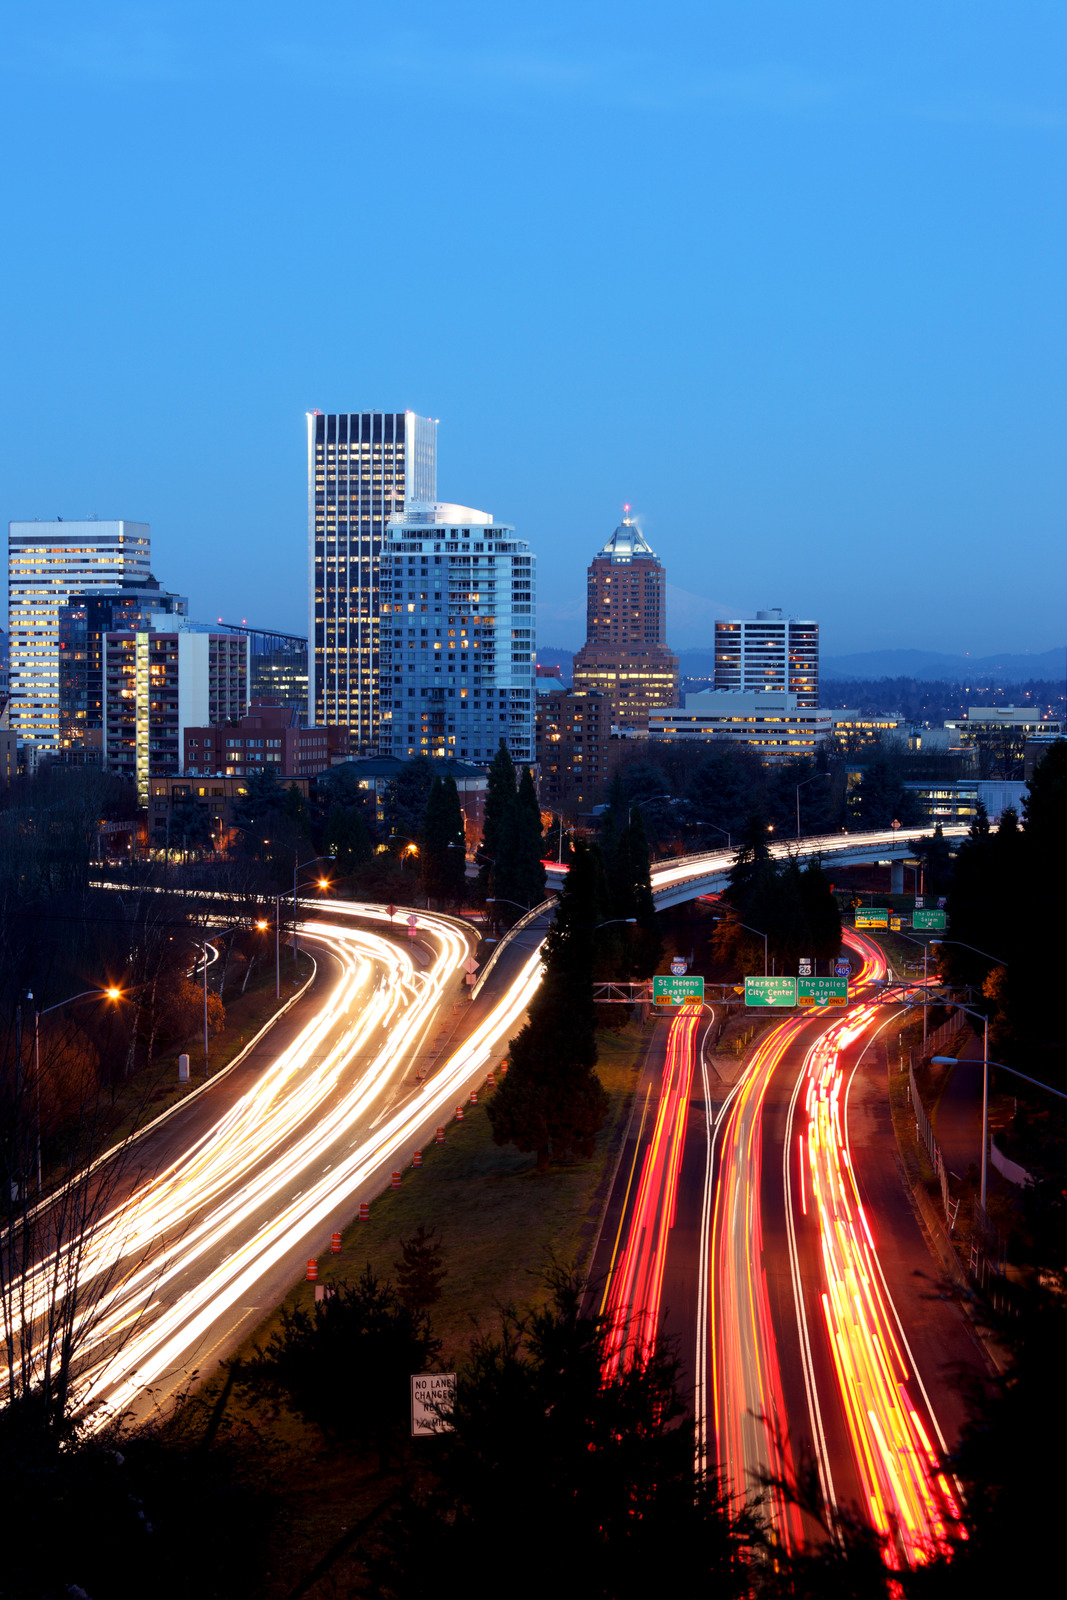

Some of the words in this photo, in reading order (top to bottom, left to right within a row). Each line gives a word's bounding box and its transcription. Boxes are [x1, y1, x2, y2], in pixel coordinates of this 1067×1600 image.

[748, 989, 764, 997] City
[415, 1380, 427, 1389] NO
[431, 1378, 452, 1388] LANE
[414, 1389, 454, 1400] CHANGES
